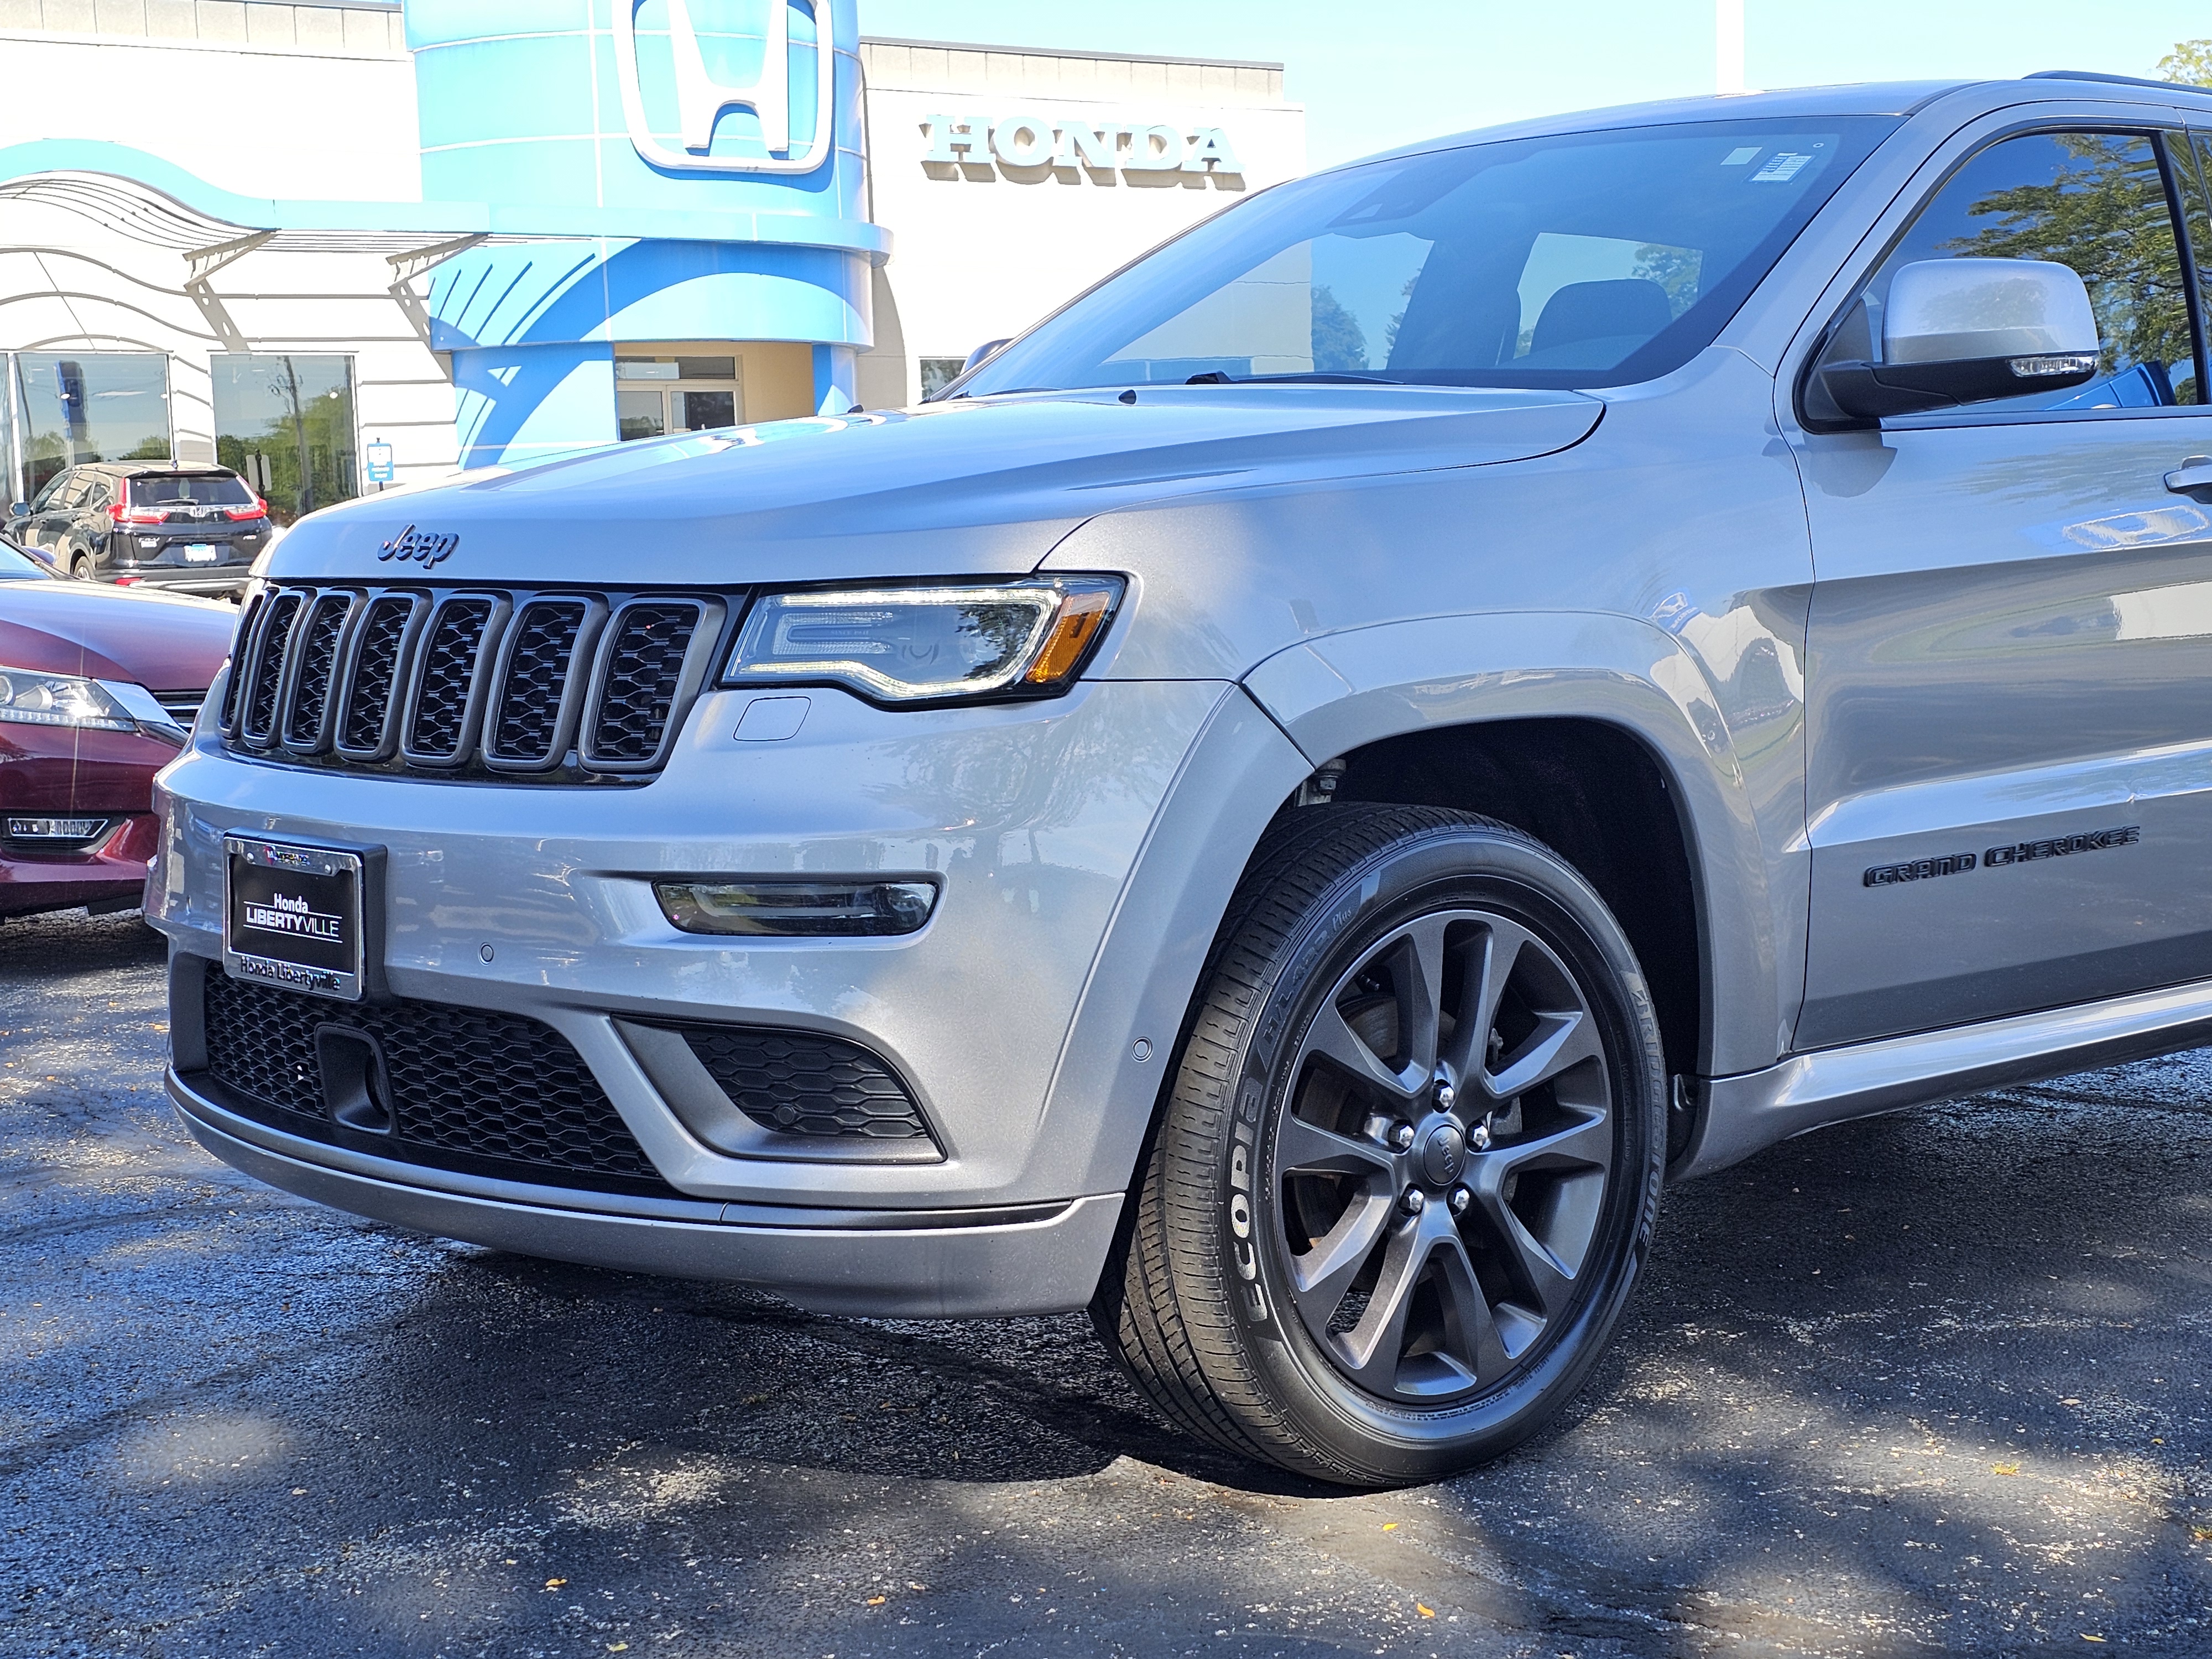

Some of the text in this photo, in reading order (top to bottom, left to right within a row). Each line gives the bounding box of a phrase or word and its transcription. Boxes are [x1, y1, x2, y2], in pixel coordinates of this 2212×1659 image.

[922, 114, 1246, 178] HONDA
[377, 524, 460, 570] Jeep
[1864, 825, 2140, 888] GRAND CHEROKEE
[246, 906, 340, 937] LIBERTYVILLE
[274, 893, 309, 914] Honda
[241, 956, 341, 990] Honda Libertyville
[1437, 1134, 1454, 1175] Jeep
